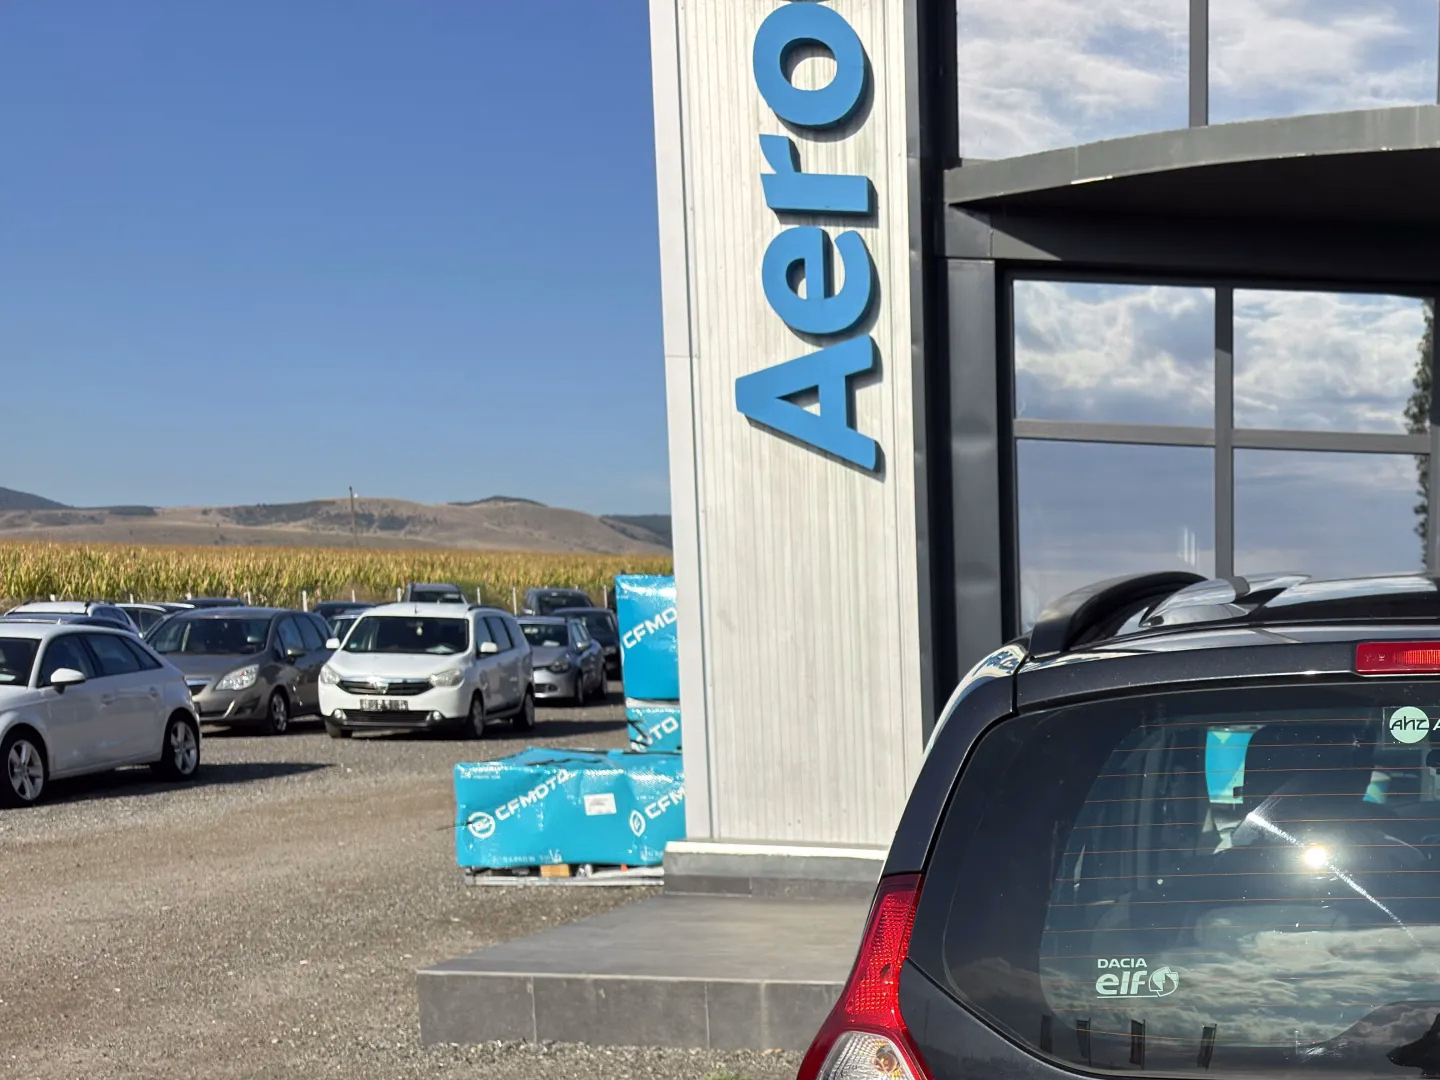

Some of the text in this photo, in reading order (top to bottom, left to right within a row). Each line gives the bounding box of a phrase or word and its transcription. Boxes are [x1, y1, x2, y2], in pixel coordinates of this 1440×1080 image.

[735, 1, 876, 471] Aero
[1097, 958, 1147, 969] DACIA
[1096, 970, 1147, 995] elf
